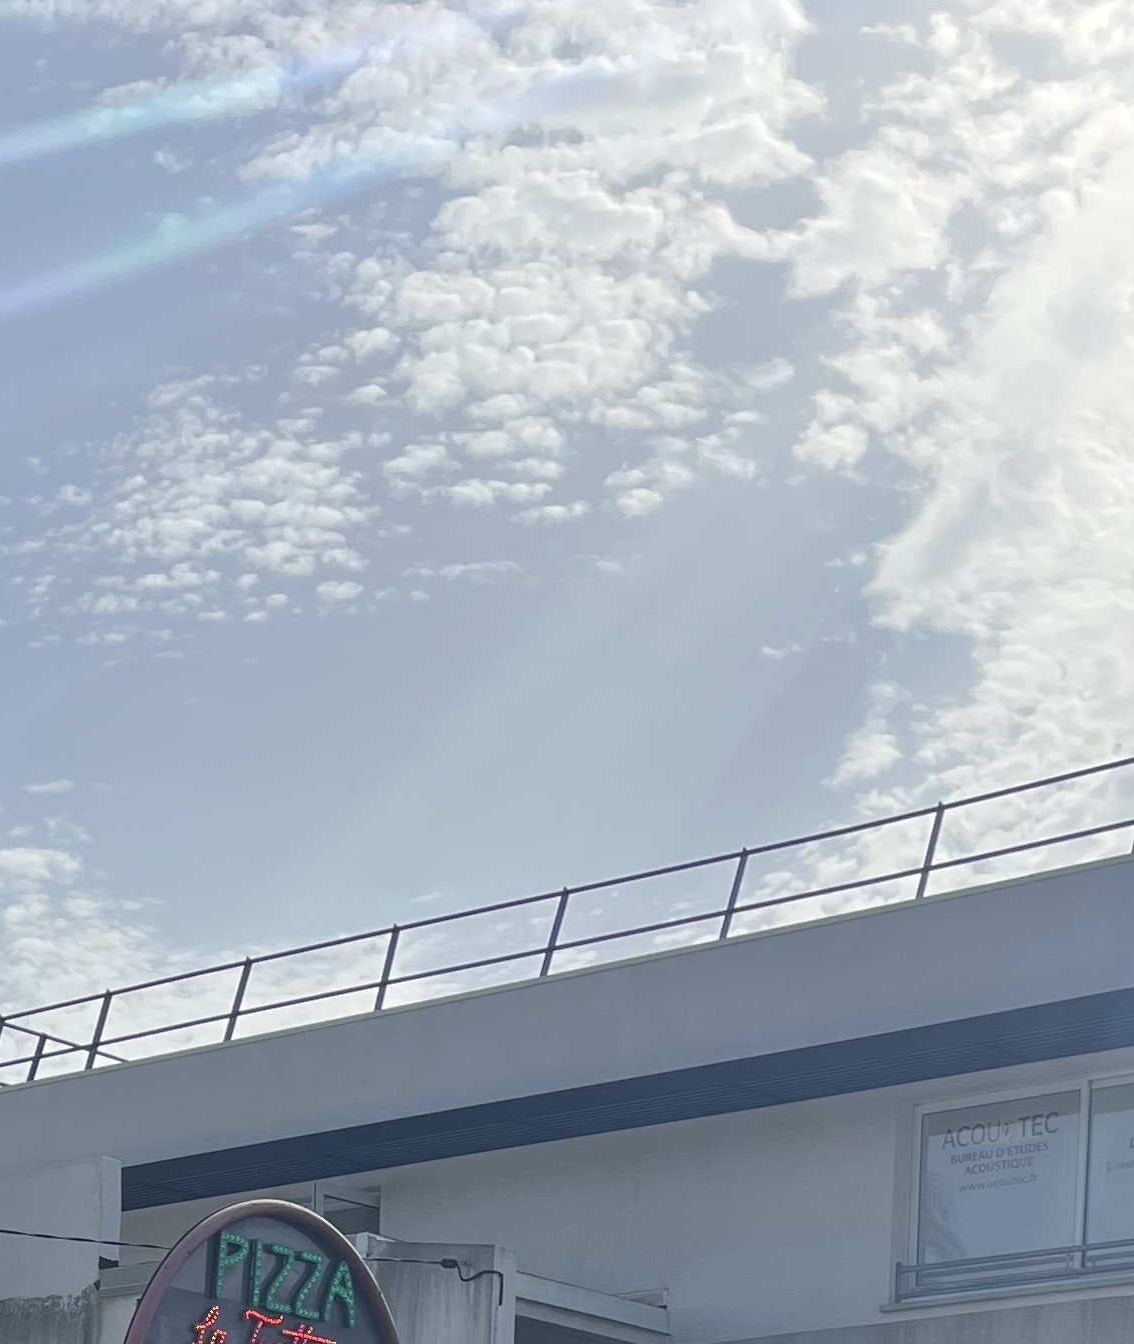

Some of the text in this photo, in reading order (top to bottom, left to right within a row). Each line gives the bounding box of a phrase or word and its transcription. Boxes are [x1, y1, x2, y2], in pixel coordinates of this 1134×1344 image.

[950, 1149, 993, 1165] BUREAU
[965, 1156, 1034, 1176] ACOUSTIQUE
[216, 1230, 355, 1329] PIZZA
